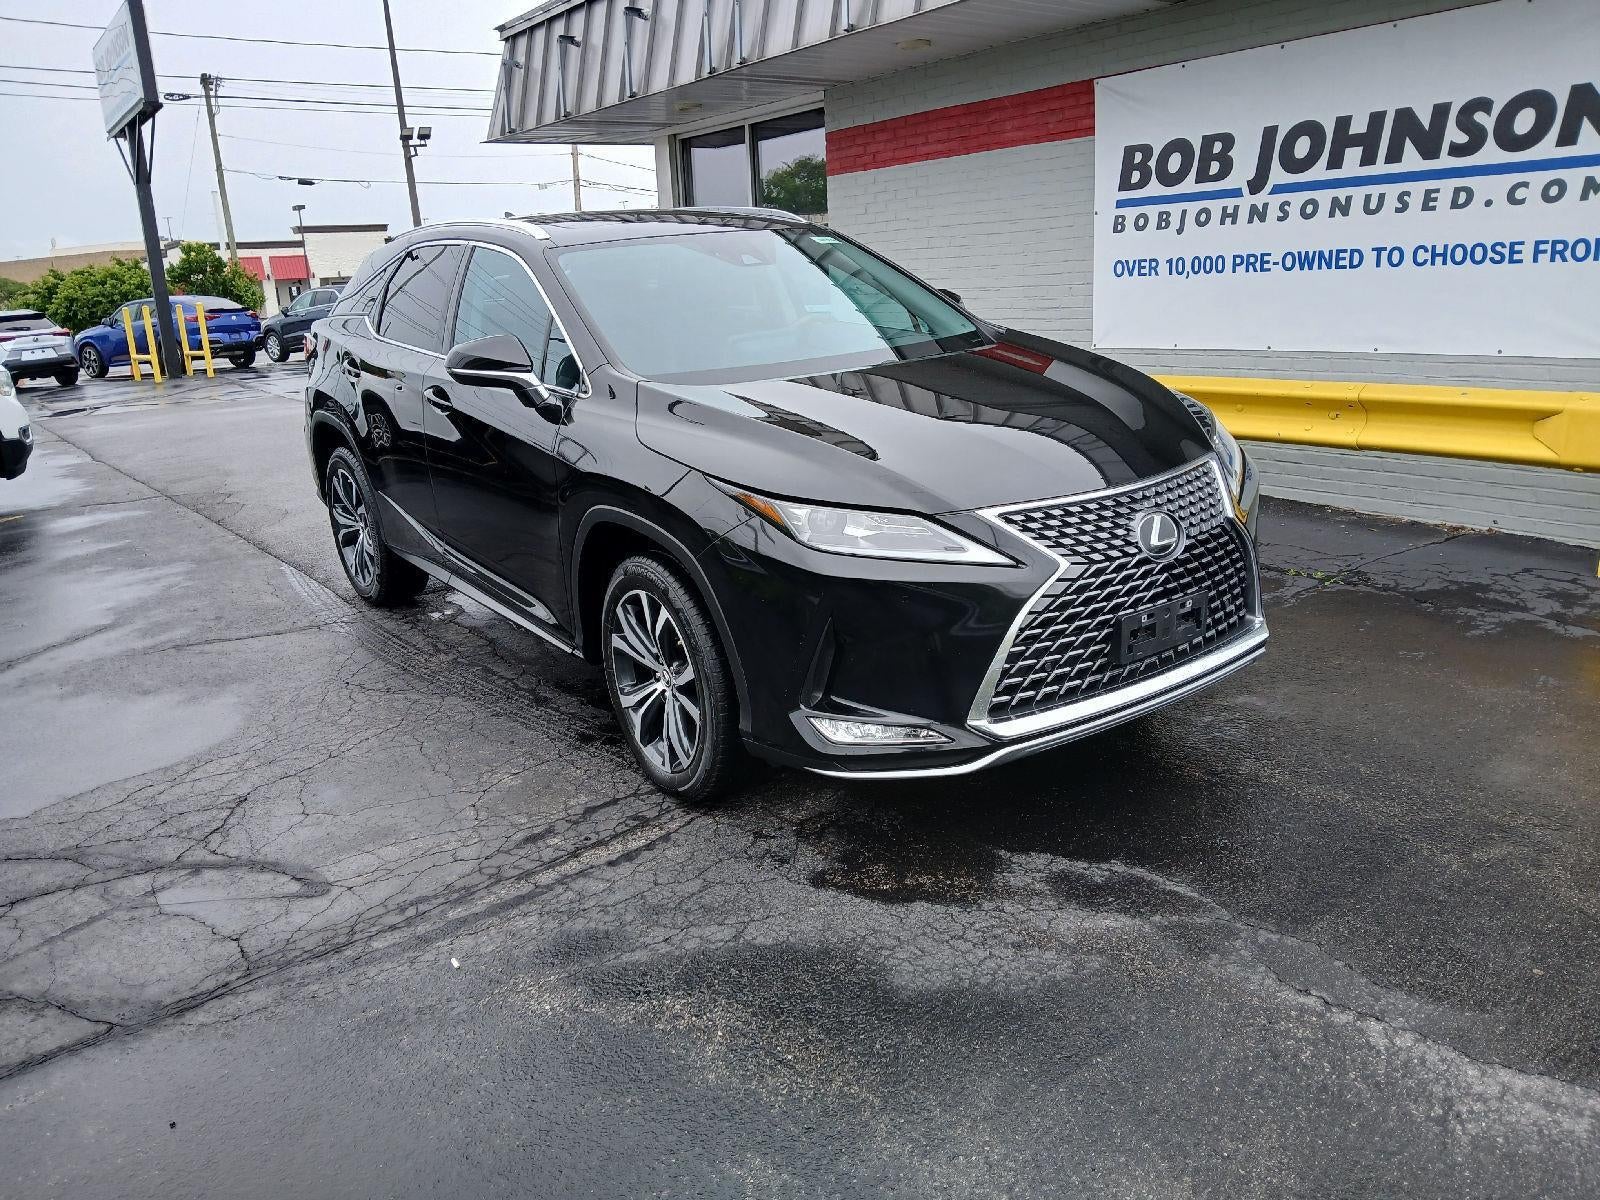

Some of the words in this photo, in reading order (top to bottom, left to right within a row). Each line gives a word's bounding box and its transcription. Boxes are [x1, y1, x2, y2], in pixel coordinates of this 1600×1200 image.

[1117, 131, 1237, 193] BOB
[1247, 82, 1600, 196] JOHNSON
[1112, 175, 1600, 236] BOBJOHNSONUSED.COM
[1112, 258, 1160, 279] OVER
[1165, 254, 1226, 279] 10,000
[1230, 247, 1365, 274] PRE-OWNED
[1371, 244, 1406, 270] TO
[1411, 239, 1525, 269] CHOOSE
[1532, 235, 1600, 265] FRO
